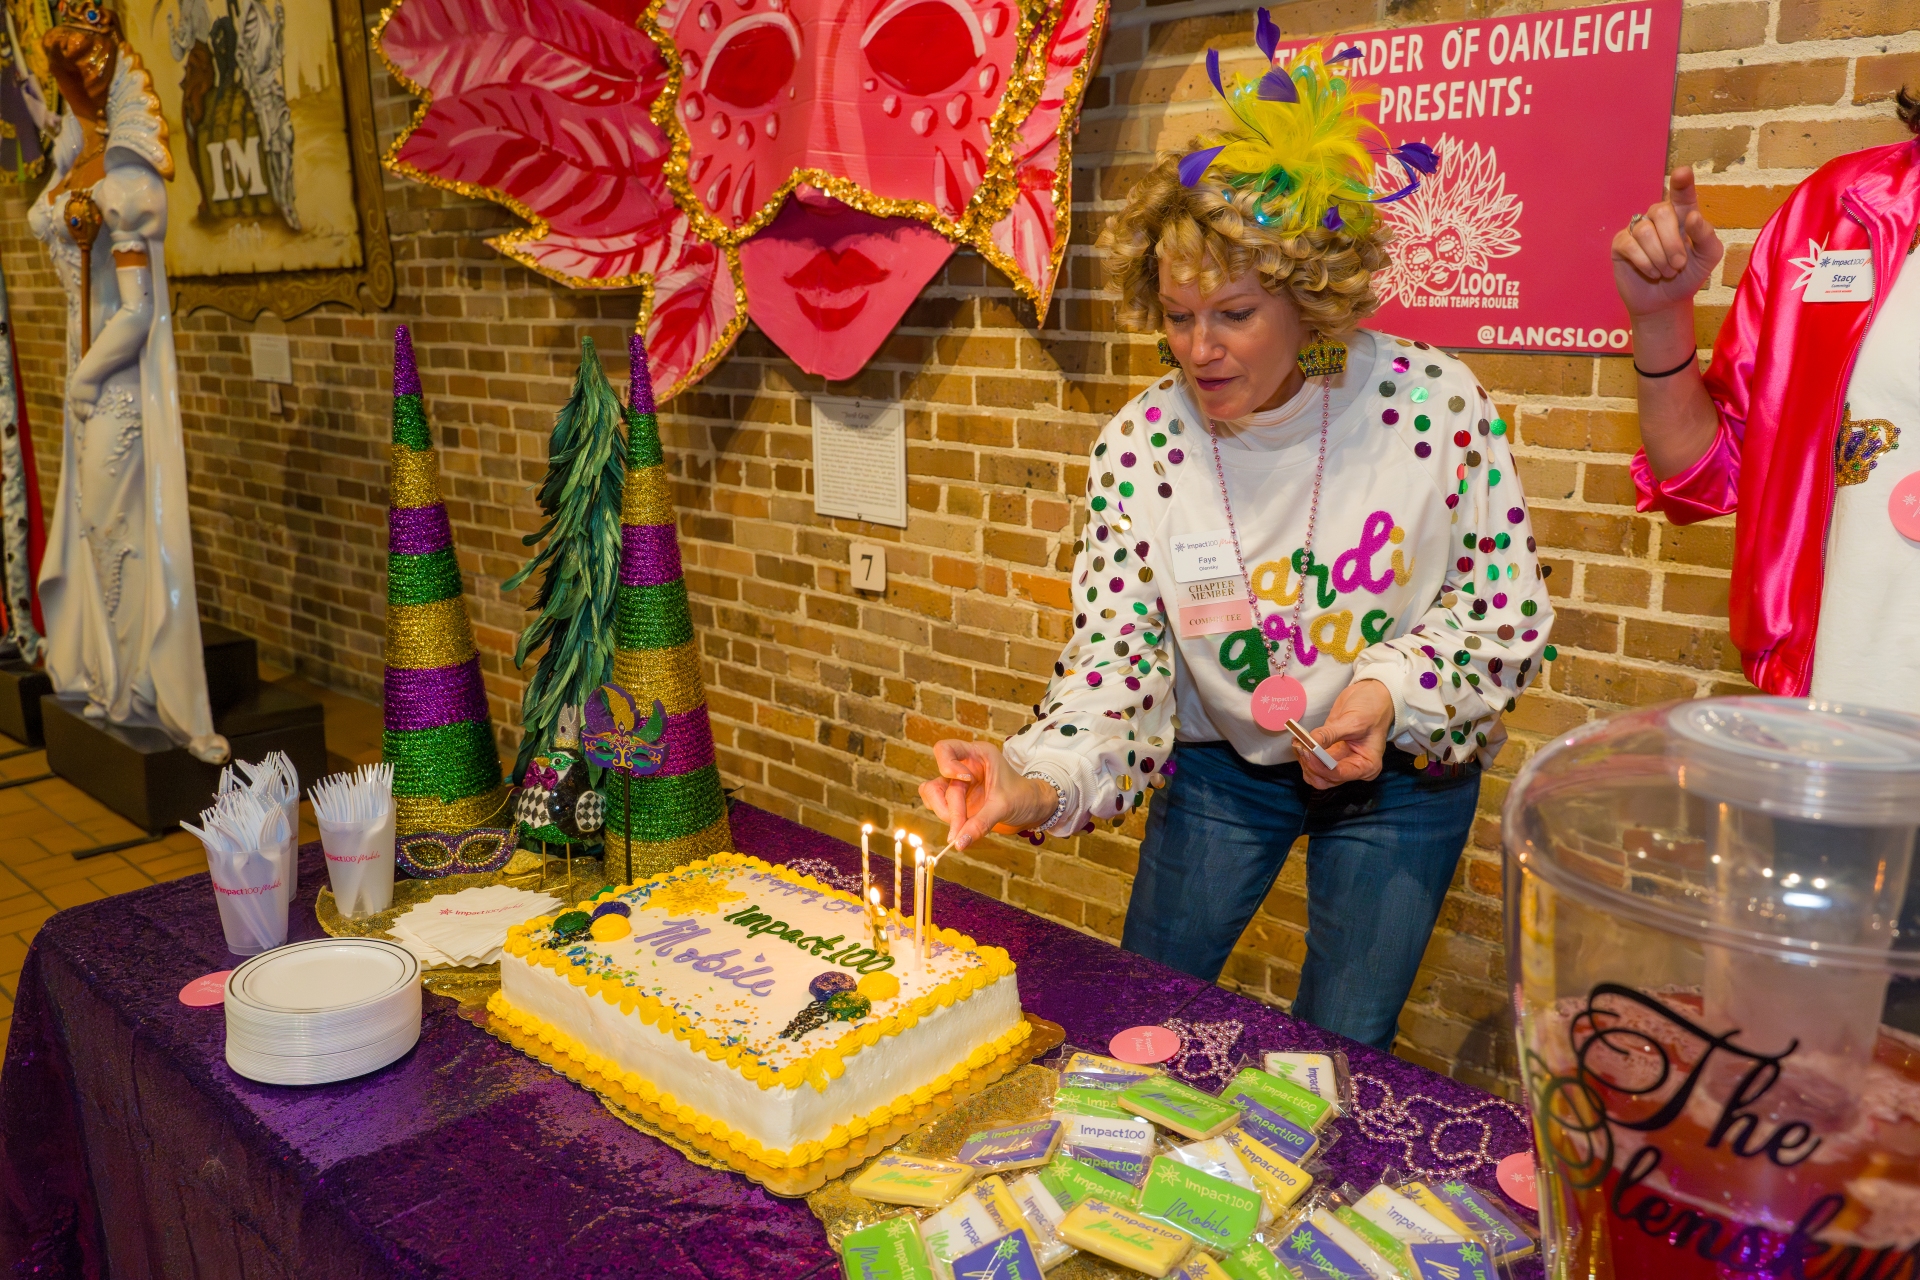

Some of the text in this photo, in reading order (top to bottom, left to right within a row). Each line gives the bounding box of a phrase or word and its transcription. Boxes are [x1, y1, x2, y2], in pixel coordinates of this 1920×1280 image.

[1332, 34, 1423, 78] ORDER
[1441, 27, 1480, 71] OF
[1488, 8, 1652, 65] OAKLEIGH
[1378, 76, 1532, 125] PRESENTS:
[207, 136, 268, 201] IM
[1832, 258, 1865, 267] Impact100
[1832, 274, 1856, 284] Stacy
[1412, 296, 1519, 309] LES BON TEMPS ROULER
[1477, 325, 1632, 349] @LANGSLOO
[1187, 540, 1218, 550] Impact100
[860, 554, 873, 581] 7
[1198, 556, 1217, 564] Faye
[1250, 510, 1415, 608] ardi
[1188, 580, 1235, 593] CHAPTER
[1191, 588, 1235, 601] MEMBER
[219, 887, 258, 896] Impact100
[455, 908, 498, 916] Impact100
[634, 918, 775, 997] Mobile
[1571, 982, 1821, 1167] The
[1171, 1085, 1227, 1113] Impact100
[1260, 1082, 1317, 1112] Impact100
[991, 1123, 1052, 1139] Impact100
[1080, 1124, 1145, 1140] Impact100
[1250, 1110, 1305, 1146] Impact100
[1076, 1154, 1143, 1172] Impact100
[1241, 1145, 1297, 1187] Impact100
[1185, 1178, 1254, 1212] Impact100
[1112, 1211, 1182, 1242] Impact100
[1163, 1197, 1231, 1238] Mobile
[960, 1217, 983, 1247] Impac
